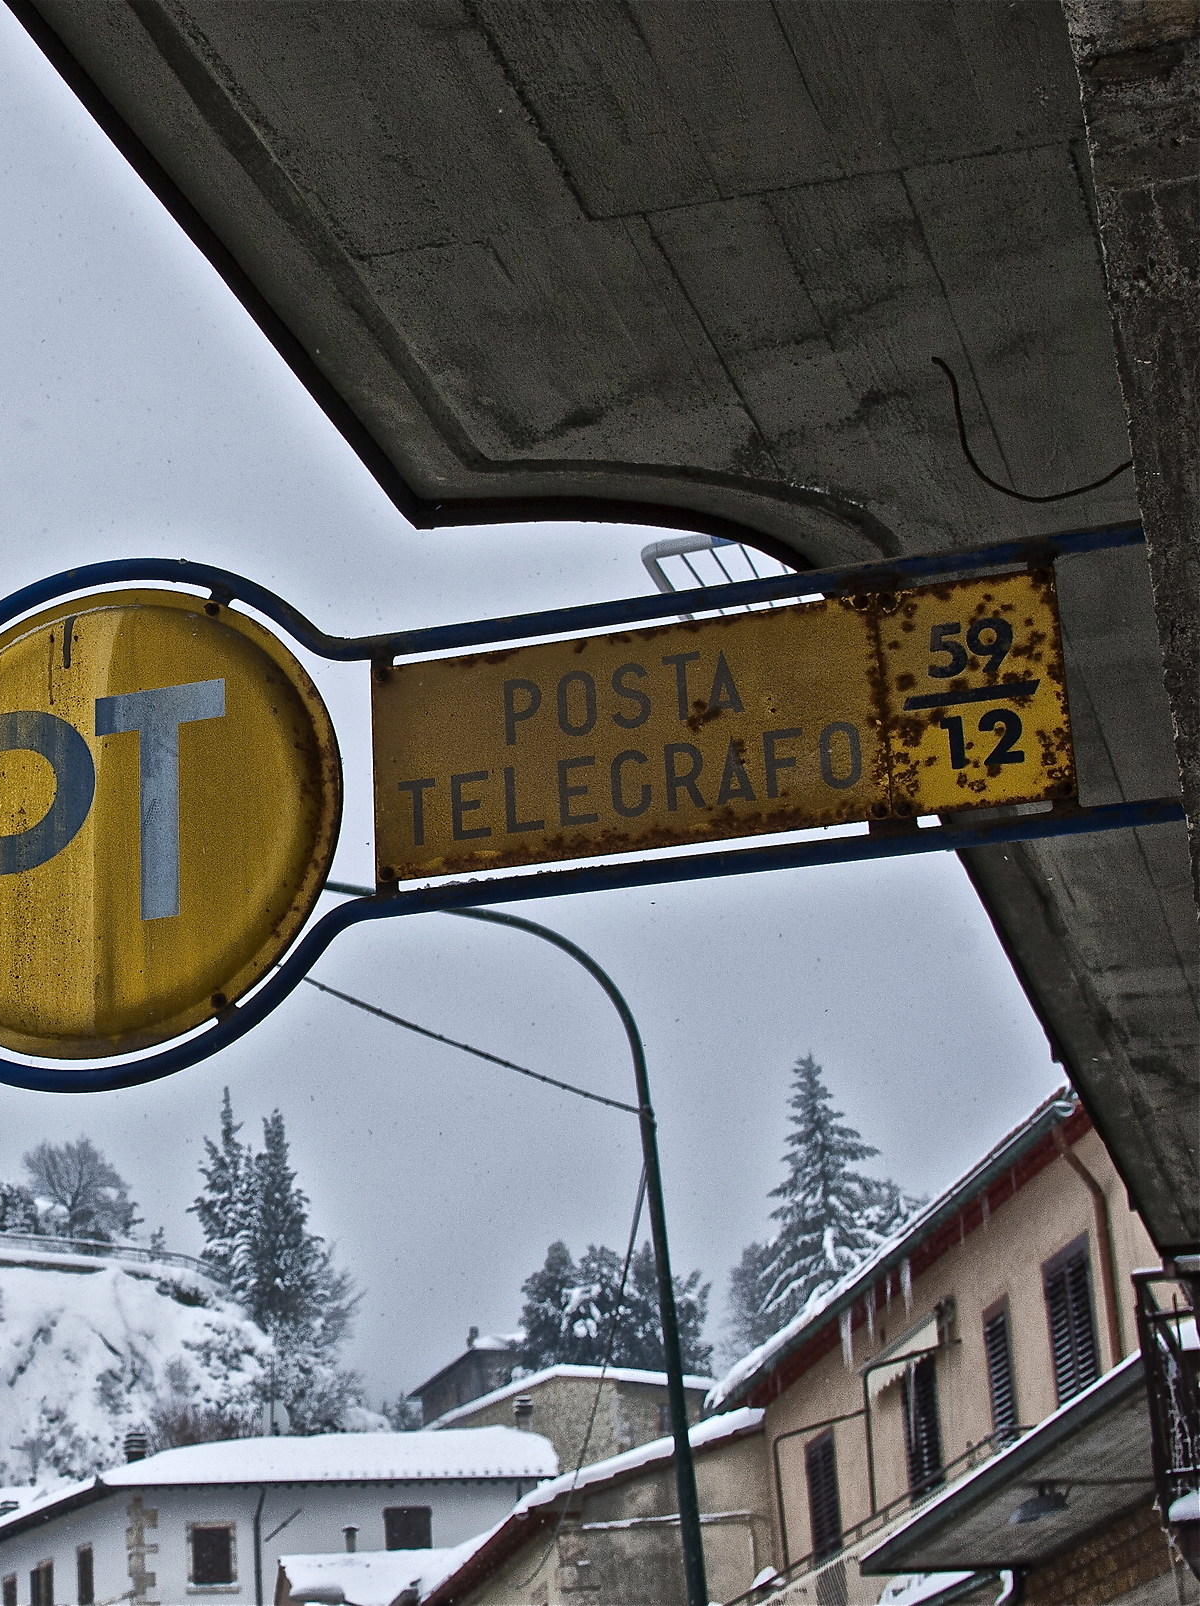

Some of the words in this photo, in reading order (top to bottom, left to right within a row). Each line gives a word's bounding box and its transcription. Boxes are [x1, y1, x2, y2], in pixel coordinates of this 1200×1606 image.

[927, 618, 1013, 679] 59
[503, 650, 744, 746] POSTA
[940, 709, 1024, 769] 12
[397, 721, 862, 846] TELEGRAFO
